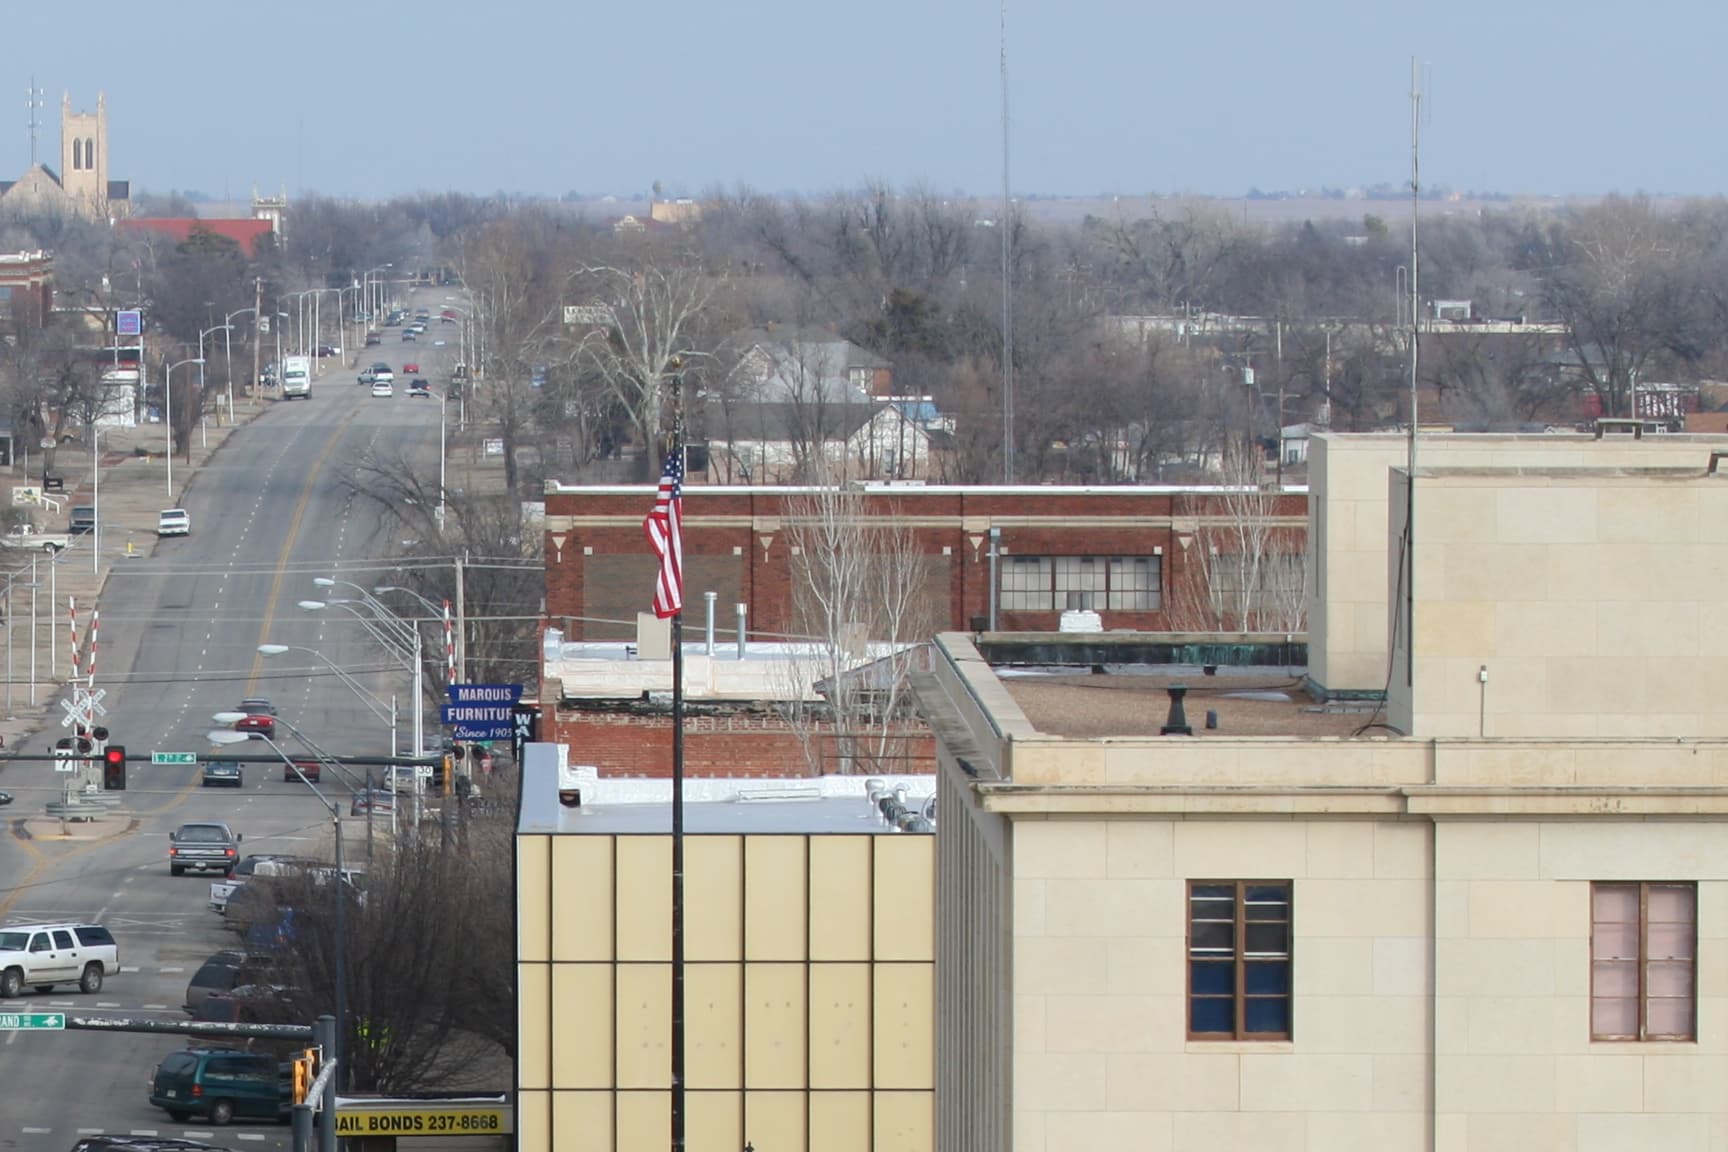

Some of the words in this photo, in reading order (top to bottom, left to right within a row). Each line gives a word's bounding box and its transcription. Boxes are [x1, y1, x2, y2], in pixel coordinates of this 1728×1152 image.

[458, 688, 512, 701] MARQUIS
[456, 726, 487, 738] Since
[368, 1116, 424, 1131] BONDS
